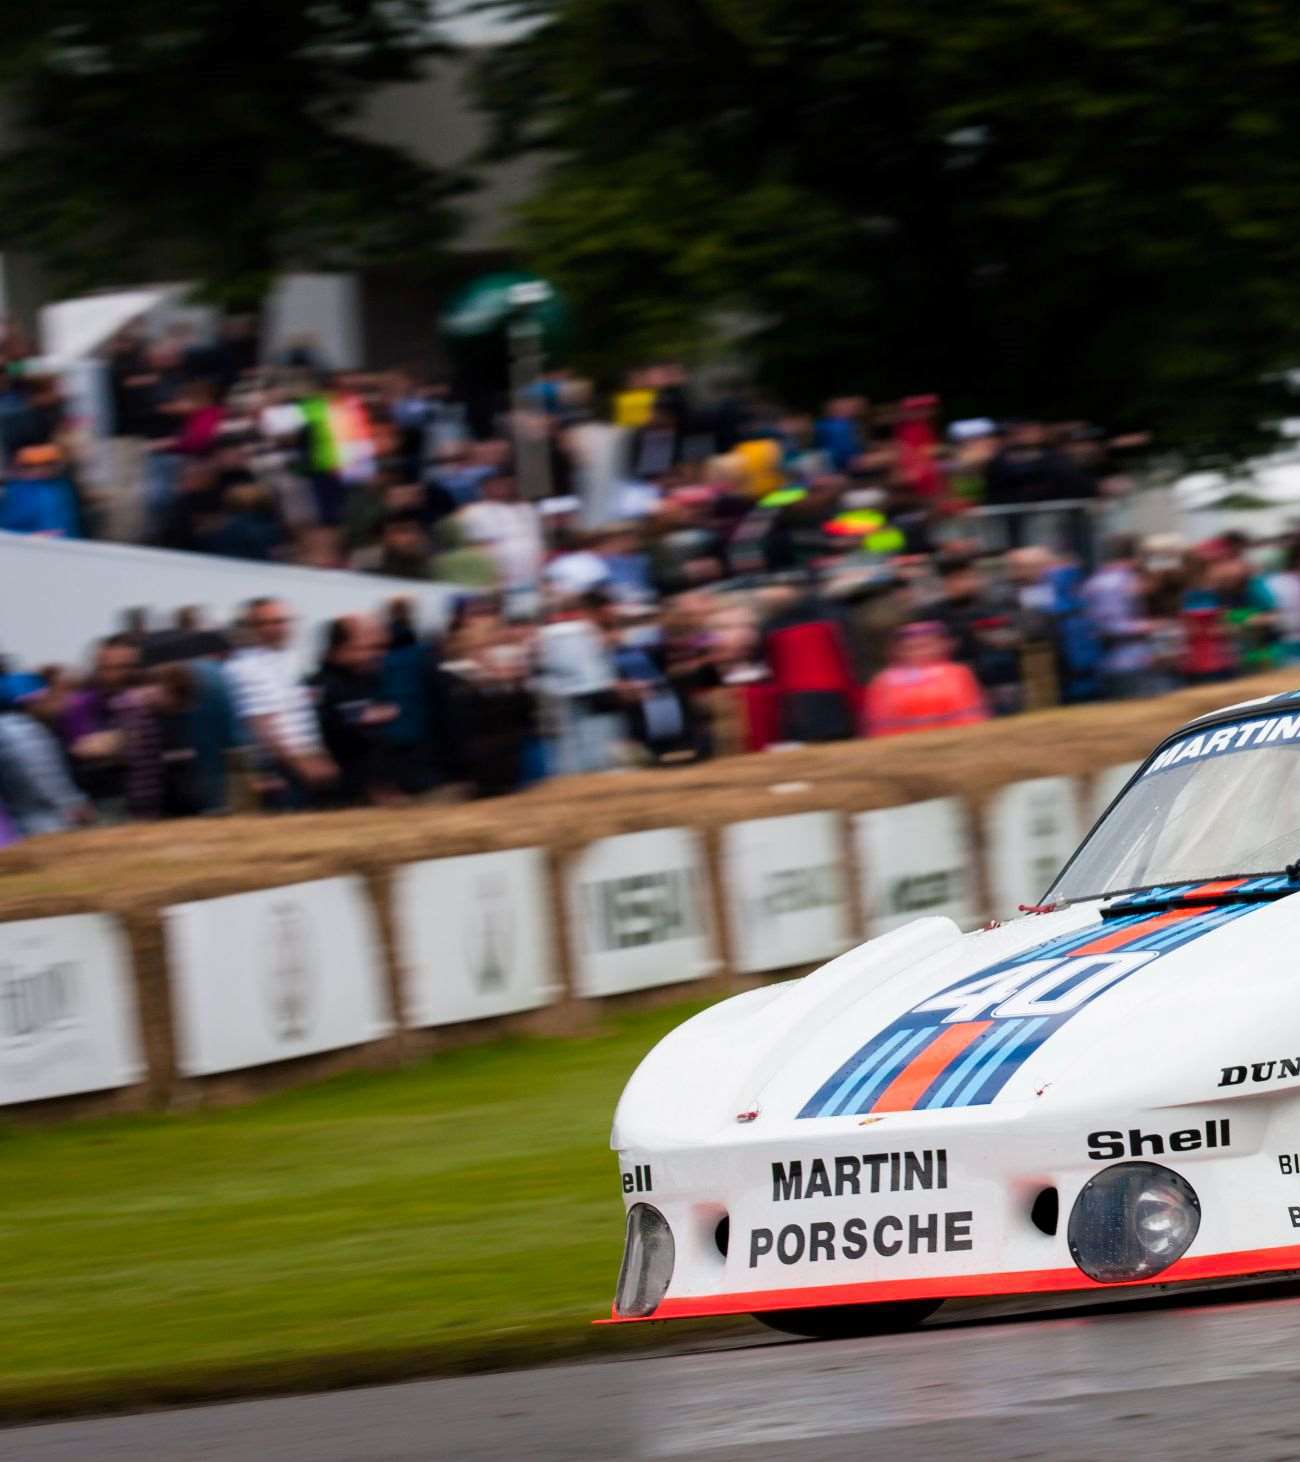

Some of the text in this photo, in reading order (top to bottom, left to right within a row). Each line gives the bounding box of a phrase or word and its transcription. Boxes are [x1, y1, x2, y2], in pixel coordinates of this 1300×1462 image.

[911, 950, 1160, 1024] 40
[1087, 1119, 1231, 1160] Shell
[622, 1164, 652, 1194] ell
[772, 1149, 948, 1202] MARTINI
[749, 1210, 973, 1268] PORSCHE
